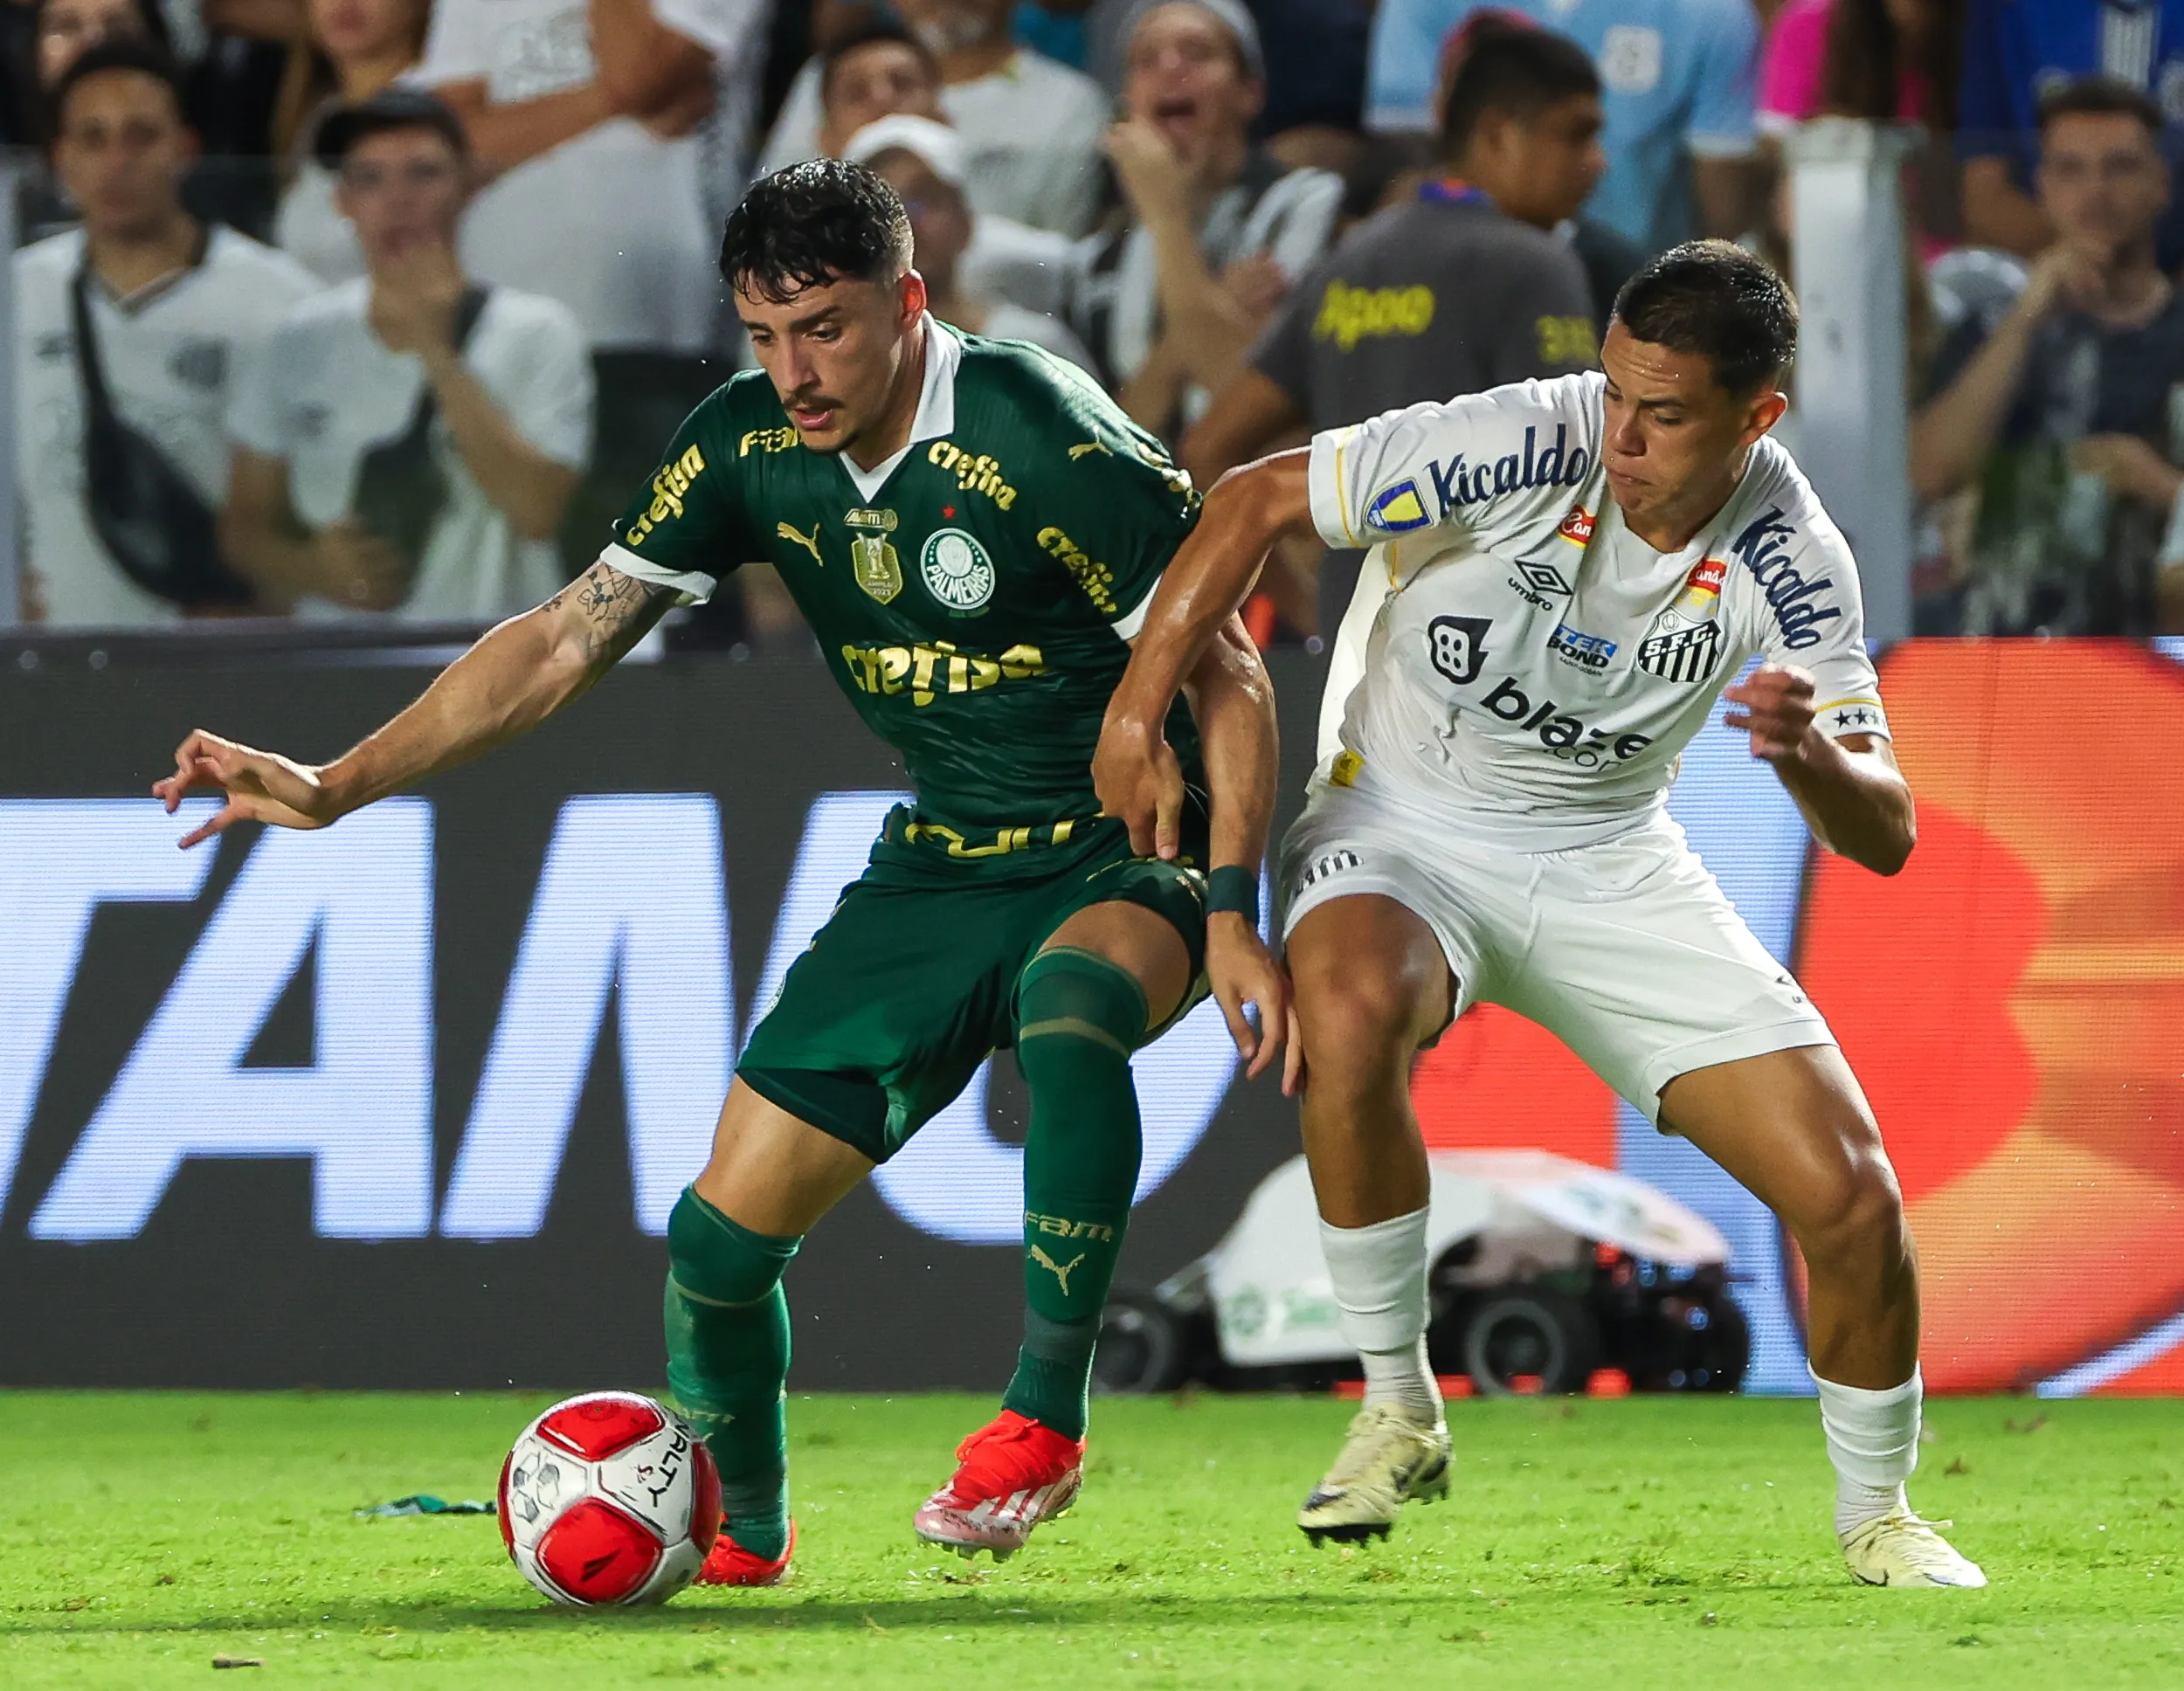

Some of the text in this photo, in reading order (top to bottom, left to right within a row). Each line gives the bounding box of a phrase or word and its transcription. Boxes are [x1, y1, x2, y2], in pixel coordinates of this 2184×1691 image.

[928, 441, 1017, 510] crefisa
[1422, 424, 1588, 518] Kicaldo
[926, 564, 990, 604] PALMEIRAS
[1508, 577, 1553, 611] umbro
[1731, 504, 1842, 650] Kicaldo
[1546, 636, 1609, 668] BOND
